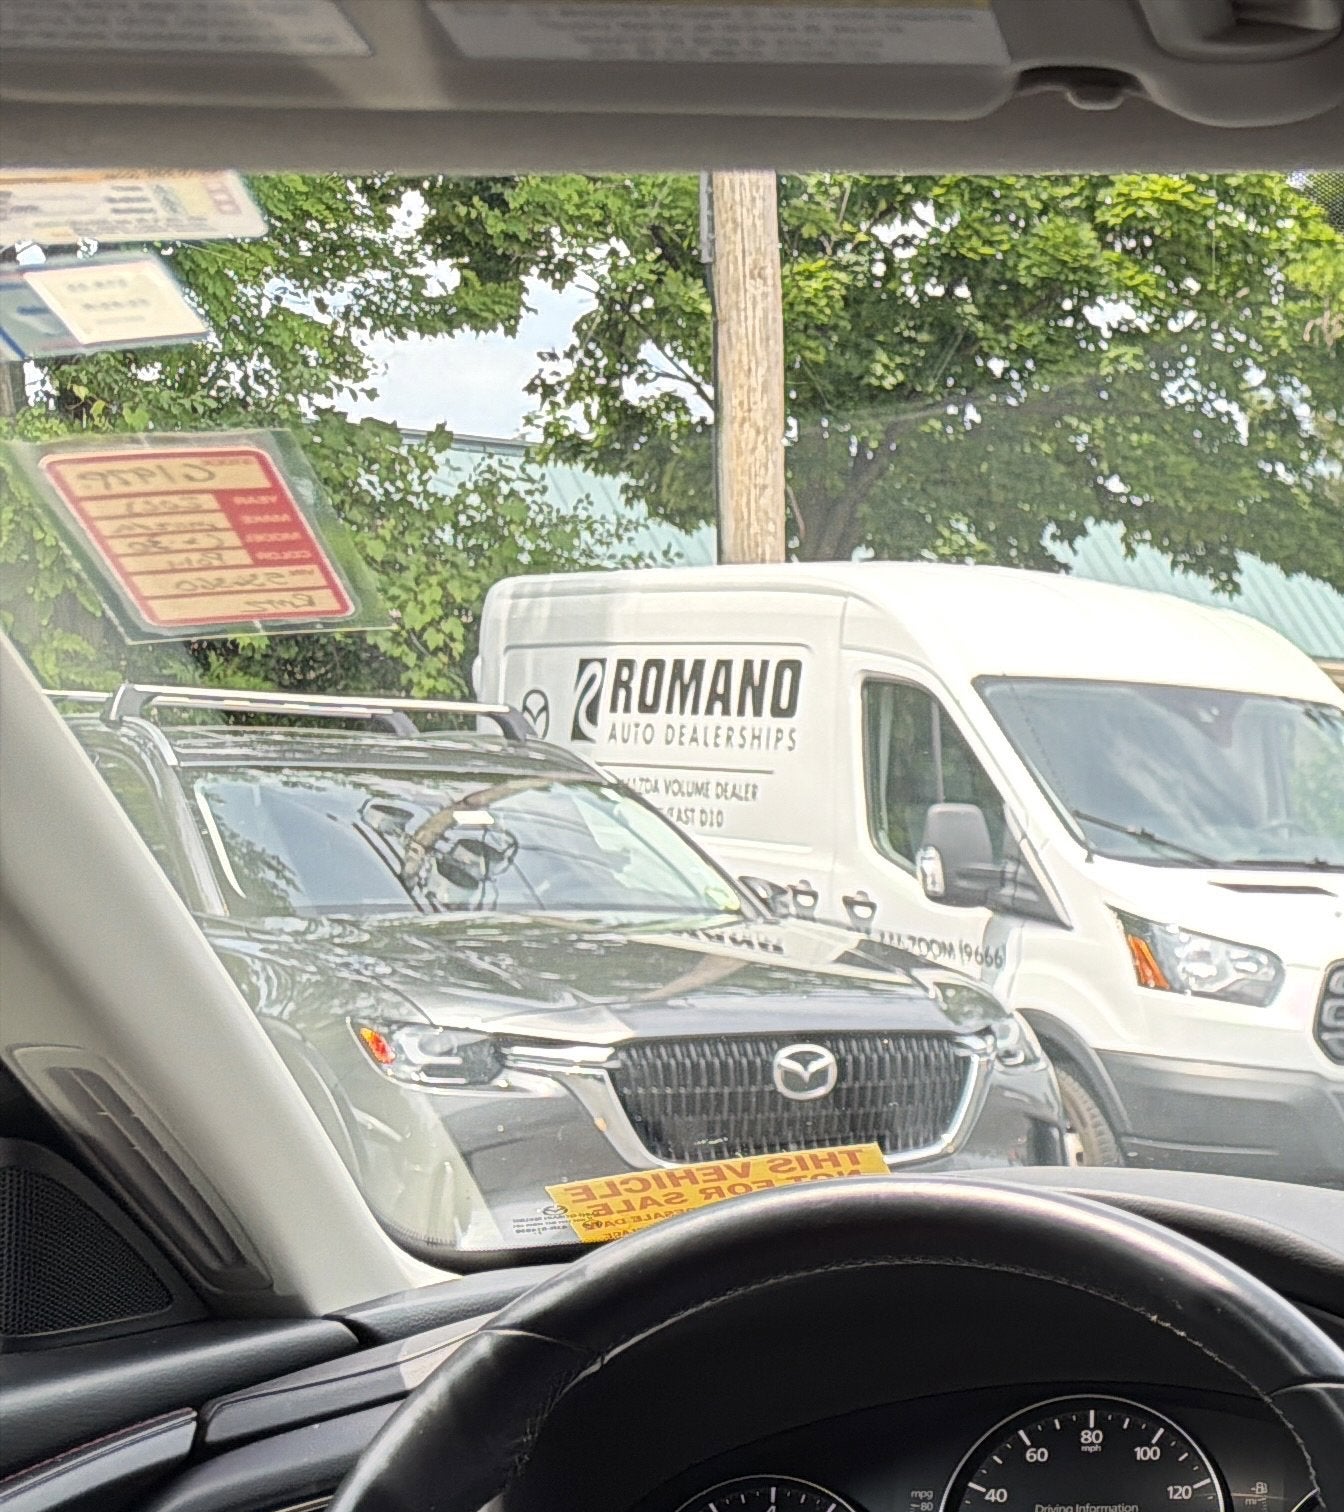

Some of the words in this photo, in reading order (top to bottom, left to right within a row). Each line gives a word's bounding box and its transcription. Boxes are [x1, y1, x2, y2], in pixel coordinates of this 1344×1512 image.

[608, 658, 803, 718] ROMANO
[607, 721, 655, 745] AUTO
[664, 723, 798, 751] DEALERSHIPS
[664, 779, 711, 799] VOLUME
[715, 781, 759, 802] DEALER
[1080, 1429, 1103, 1445] 80
[1025, 1448, 1048, 1463] 60
[1081, 1444, 1101, 1454] mph
[1134, 1446, 1160, 1461] 100
[911, 1490, 933, 1500] mpg
[985, 1489, 1008, 1503] 40
[1167, 1486, 1192, 1500] 120
[920, 1502, 933, 1512] 80
